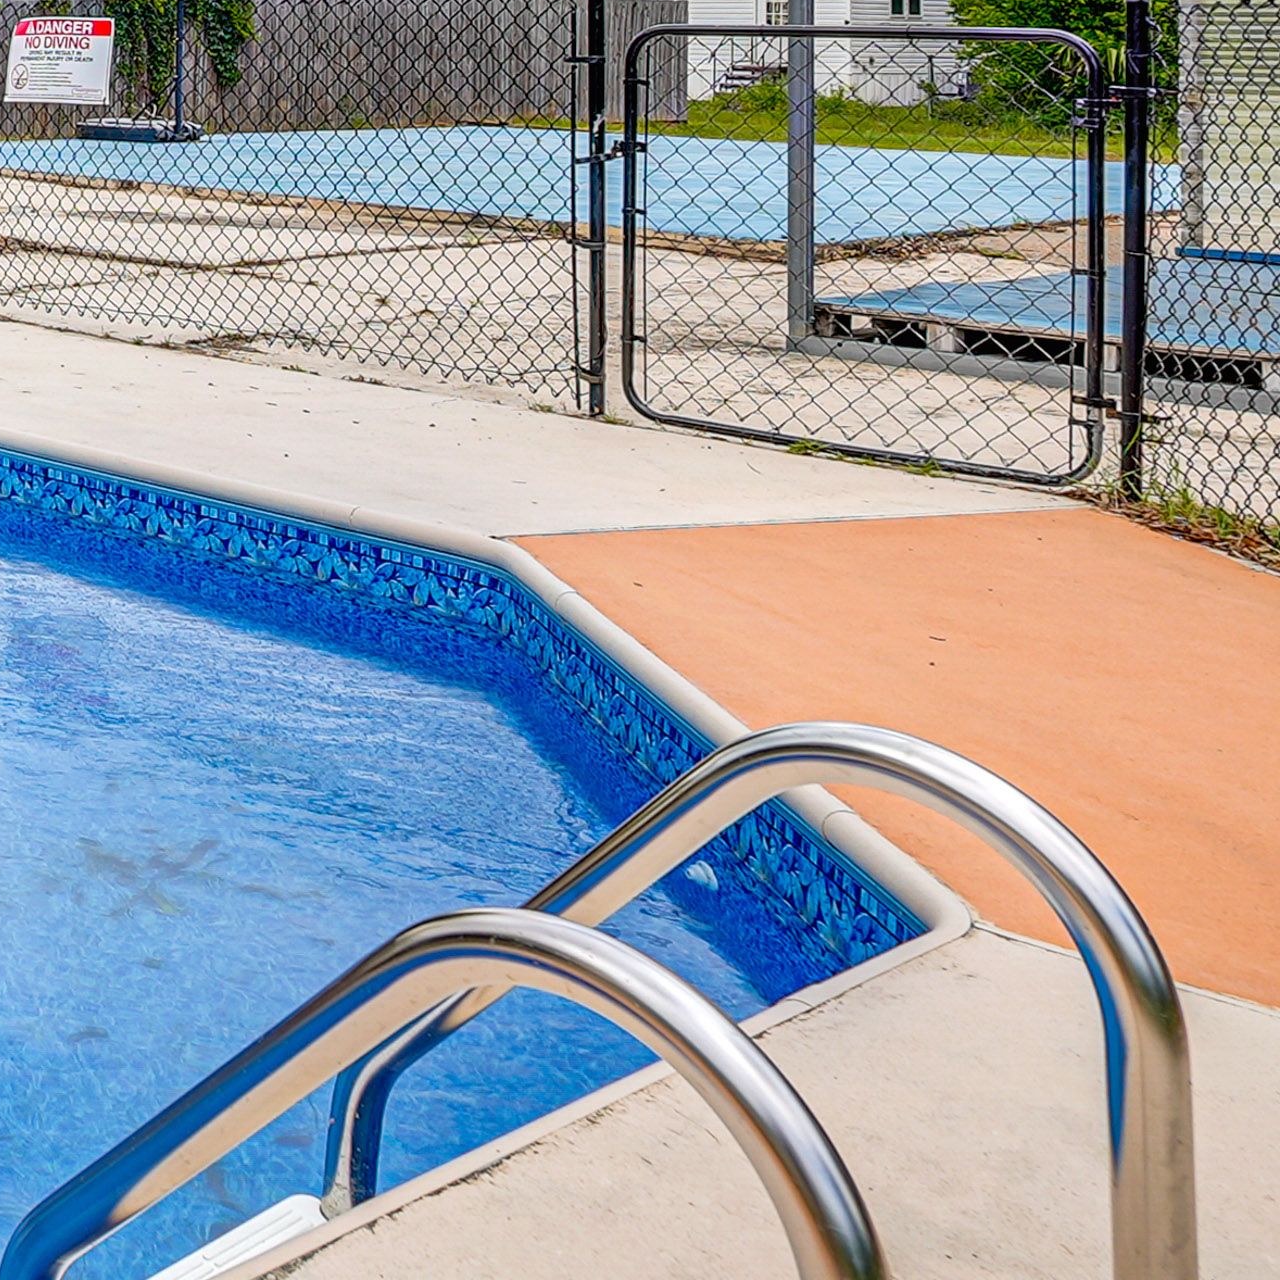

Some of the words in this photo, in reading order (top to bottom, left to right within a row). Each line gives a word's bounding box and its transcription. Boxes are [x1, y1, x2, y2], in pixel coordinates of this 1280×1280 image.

[36, 21, 93, 34] DANGER
[25, 36, 41, 49] NO
[44, 36, 90, 50] DIVING
